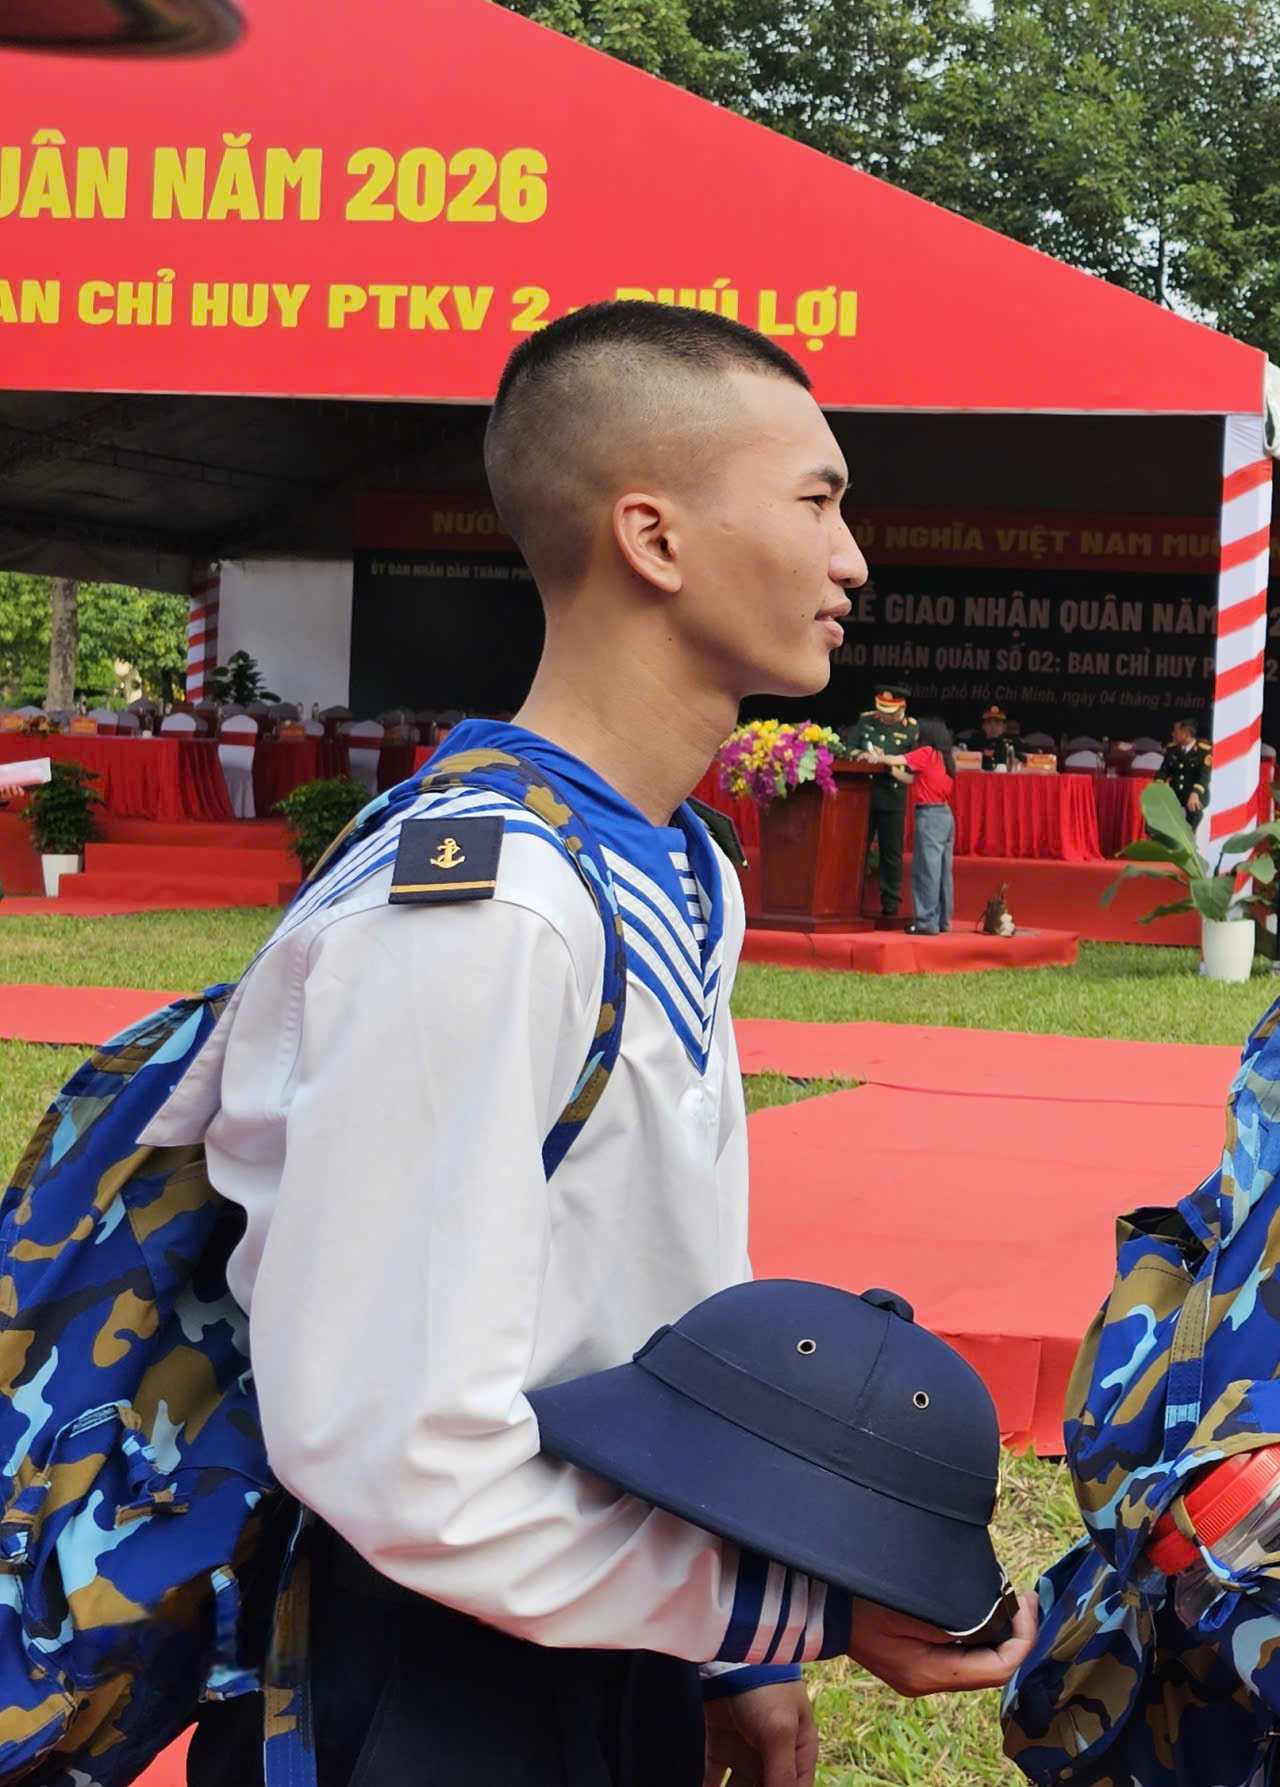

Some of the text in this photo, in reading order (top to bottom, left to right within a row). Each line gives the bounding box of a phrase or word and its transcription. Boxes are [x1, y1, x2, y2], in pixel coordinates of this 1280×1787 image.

[151, 132, 323, 221] NĂM
[345, 147, 548, 223] 2026
[77, 268, 176, 325] CHỈ
[191, 282, 311, 328] HUY
[328, 284, 494, 331] PTKV
[511, 286, 550, 331] 2
[759, 285, 858, 352] LỢI
[431, 508, 504, 537] NƯỚ
[995, 522, 1072, 560] VIỆT
[1080, 530, 1153, 558] NAM
[884, 592, 955, 625] GIAO
[963, 590, 1050, 638] NHẬN
[1059, 593, 1143, 634] QUÂN
[1152, 596, 1218, 634] NĂM
[872, 640, 930, 676] NHẬN
[935, 641, 990, 673] QUÂN
[995, 639, 1025, 673] SỐ
[1027, 650, 1063, 674] 02:
[1067, 651, 1111, 676] BAN
[1115, 644, 1151, 678] CHỈ
[1155, 654, 1197, 679] HUY
